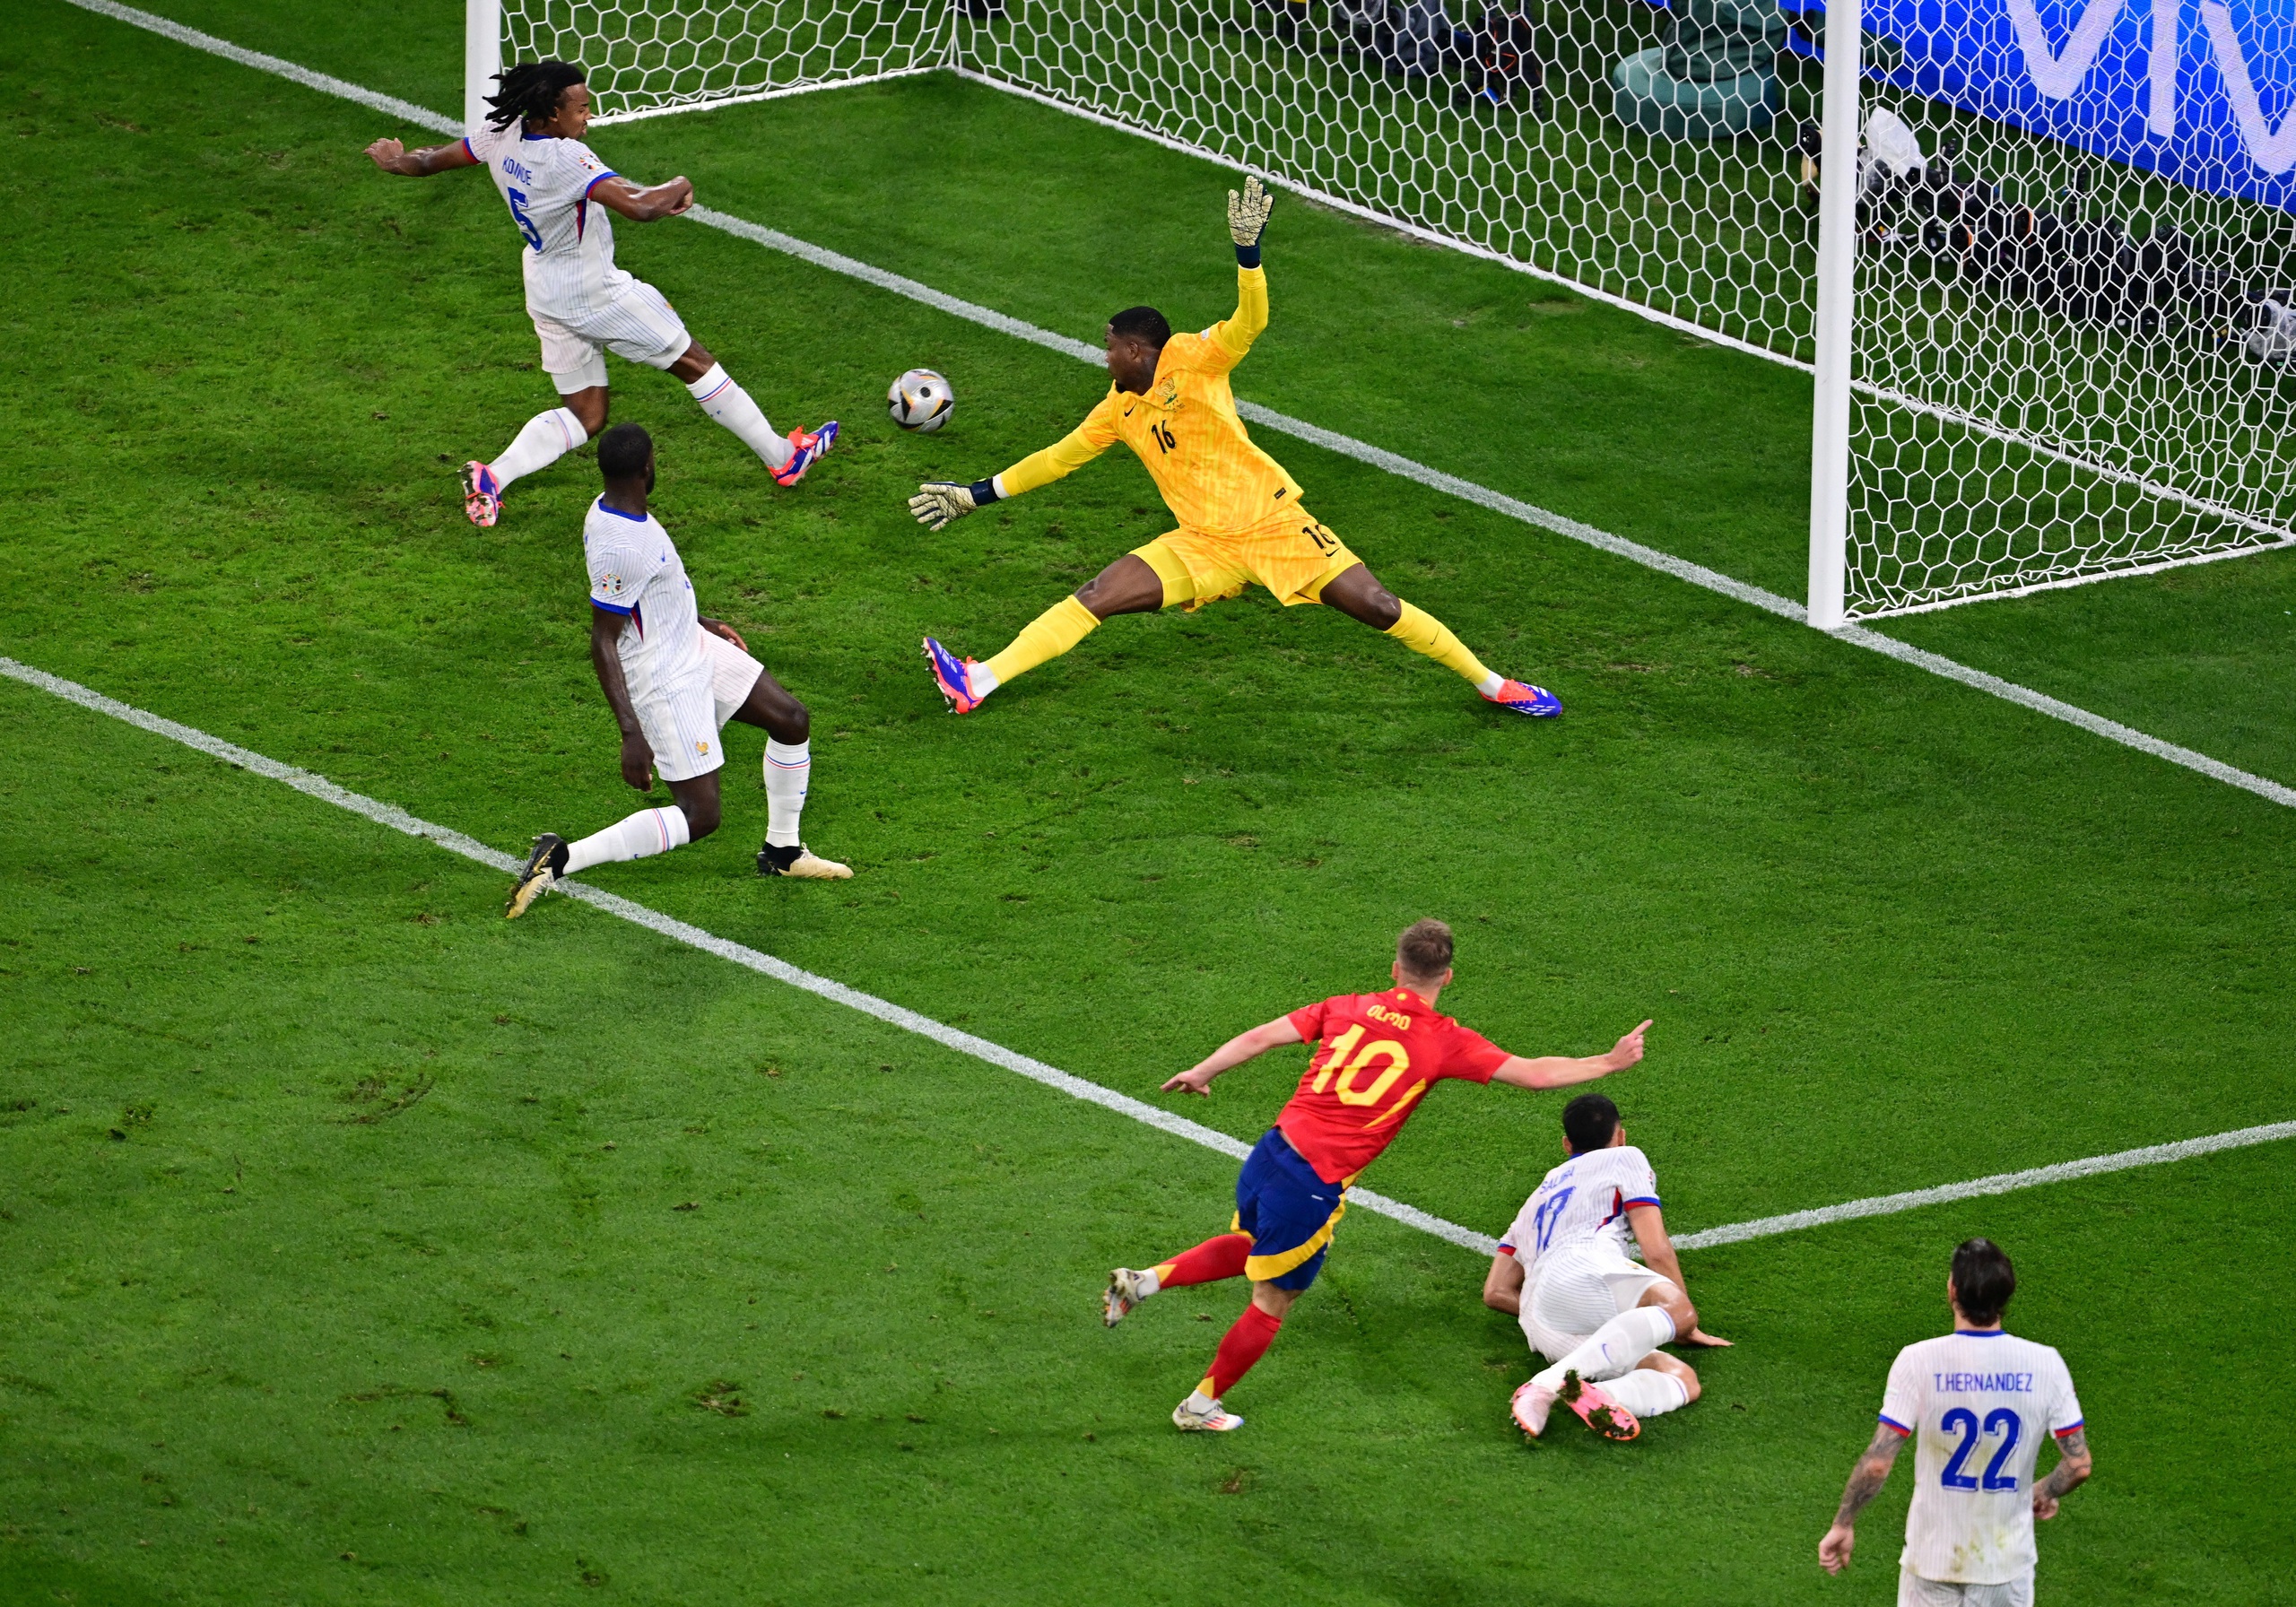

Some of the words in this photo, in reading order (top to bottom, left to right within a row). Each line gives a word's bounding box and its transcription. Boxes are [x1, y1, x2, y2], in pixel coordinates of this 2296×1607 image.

[502, 155, 532, 186] KONDE
[507, 187, 544, 252] 5
[1151, 420, 1177, 455] 16
[1366, 1004, 1412, 1030] OLMO
[1310, 1023, 1410, 1107] 10
[1532, 1186, 1577, 1257] 17
[1934, 1372, 2033, 1393] T.HERNANDEZ
[1940, 1407, 2022, 1493] 22
